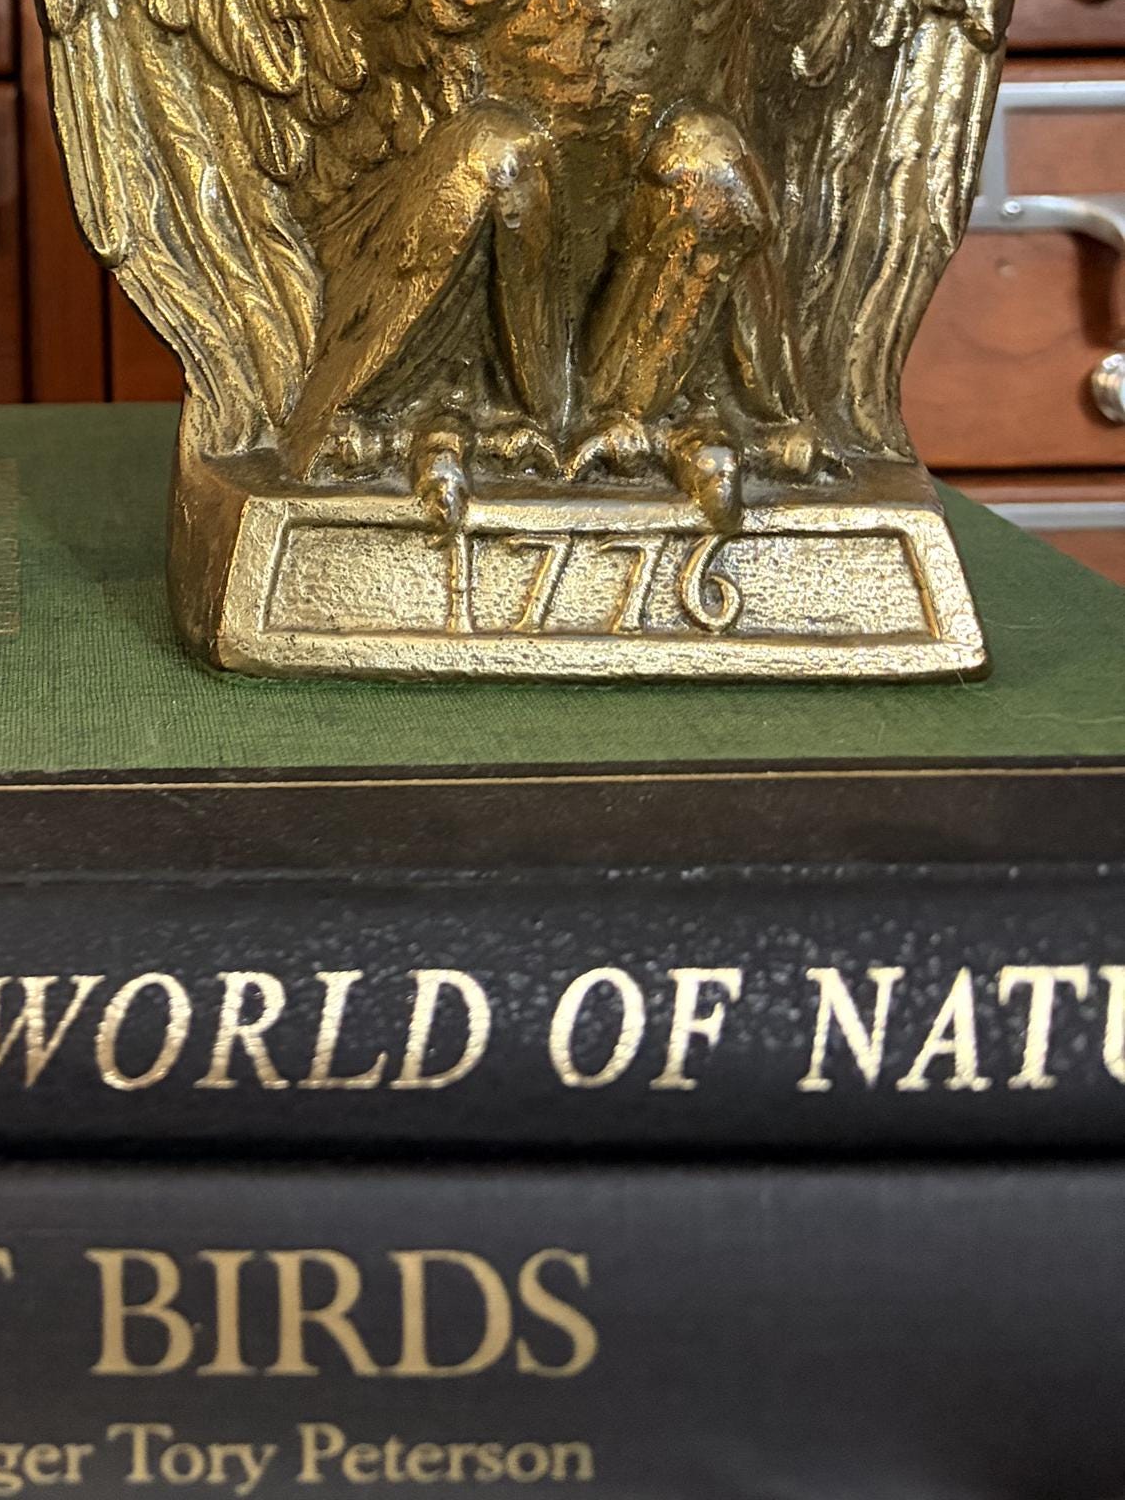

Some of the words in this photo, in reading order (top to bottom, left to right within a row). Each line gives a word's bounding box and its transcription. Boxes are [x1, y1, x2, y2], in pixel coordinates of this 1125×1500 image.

[429, 528, 745, 636] 1776
[547, 964, 745, 1091] OF
[796, 963, 1125, 1093] NAT
[84, 1245, 600, 1379] BIRDS
[105, 1422, 278, 1497] Tory
[295, 1421, 595, 1487] Peterson
